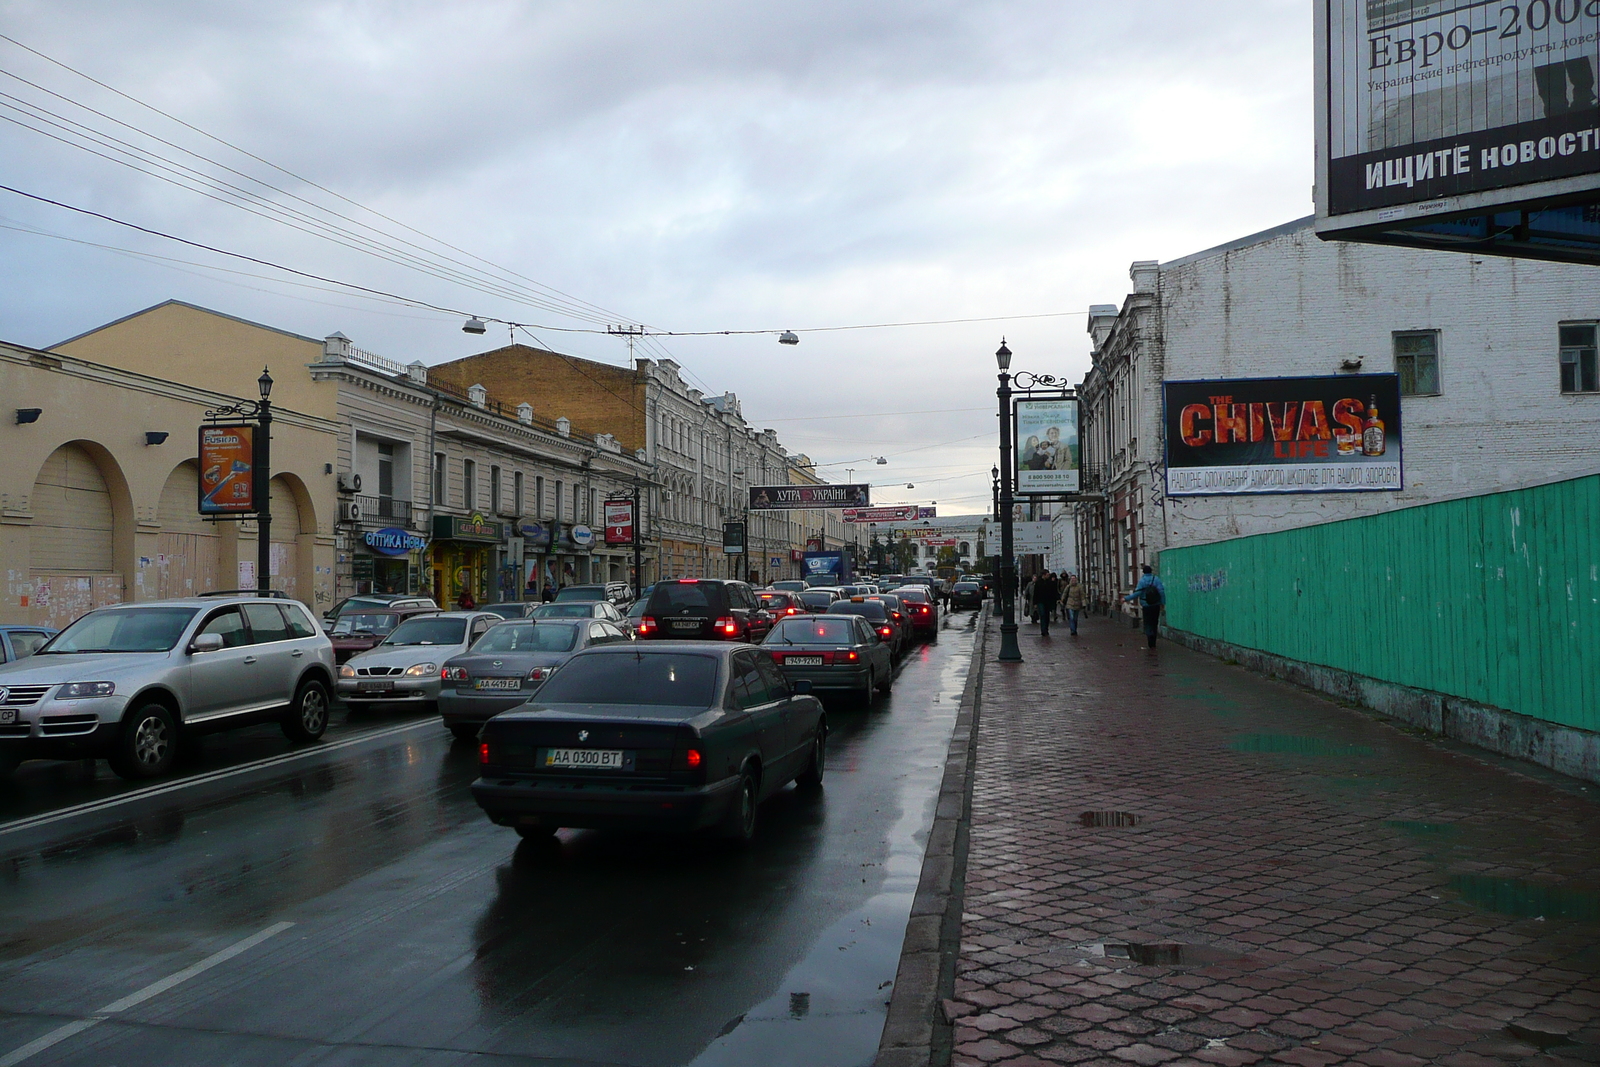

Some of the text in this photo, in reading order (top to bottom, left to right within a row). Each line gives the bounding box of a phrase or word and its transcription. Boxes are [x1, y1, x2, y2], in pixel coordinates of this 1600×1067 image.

[1367, 68, 1443, 92] Украинские
[1446, 42, 1556, 74] нефтепродукты
[1365, 144, 1470, 190] ИЩИТЕ
[1208, 395, 1233, 405] THE
[1179, 398, 1364, 447] CHIVAS
[204, 436, 238, 444] Fusion
[1273, 440, 1329, 459] LIFE
[1322, 468, 1334, 487] ДЛЯ
[777, 486, 847, 501] ХУТРА УКРАЇНИ
[365, 532, 426, 549] ОПТИКА НОВА
[479, 680, 491, 688] AA
[508, 680, 519, 688] EA
[553, 750, 619, 765] AA 0300 BT
